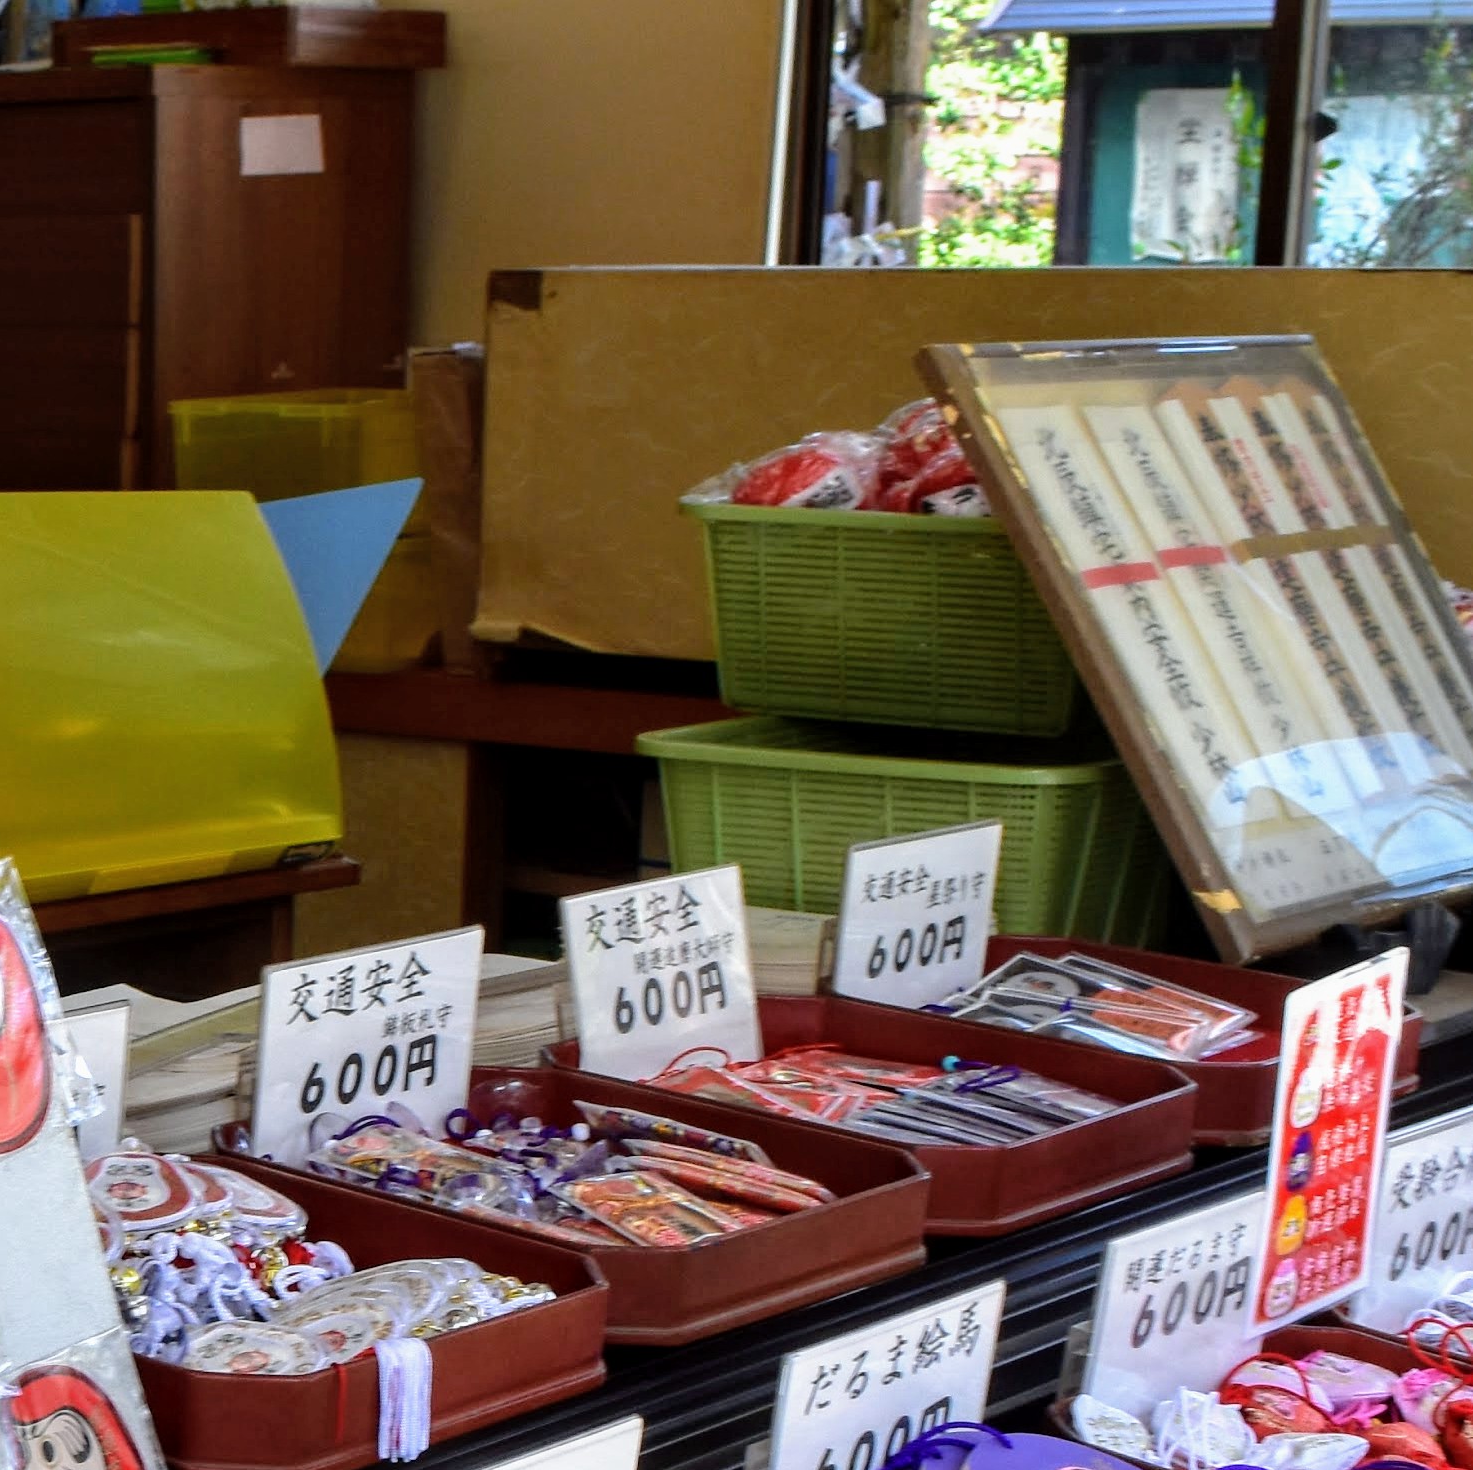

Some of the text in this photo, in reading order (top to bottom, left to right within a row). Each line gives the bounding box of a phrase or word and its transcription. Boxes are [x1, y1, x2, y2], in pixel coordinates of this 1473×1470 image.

[585, 883, 703, 953] 交通安全
[867, 913, 968, 981] 600円
[286, 950, 433, 1028] 交通安全
[613, 960, 729, 1035] 600円
[299, 1032, 440, 1115] 600円
[1388, 1145, 1473, 1213] 受験合
[1130, 1254, 1254, 1350] 600円
[804, 1300, 981, 1417] だるま絵馬
